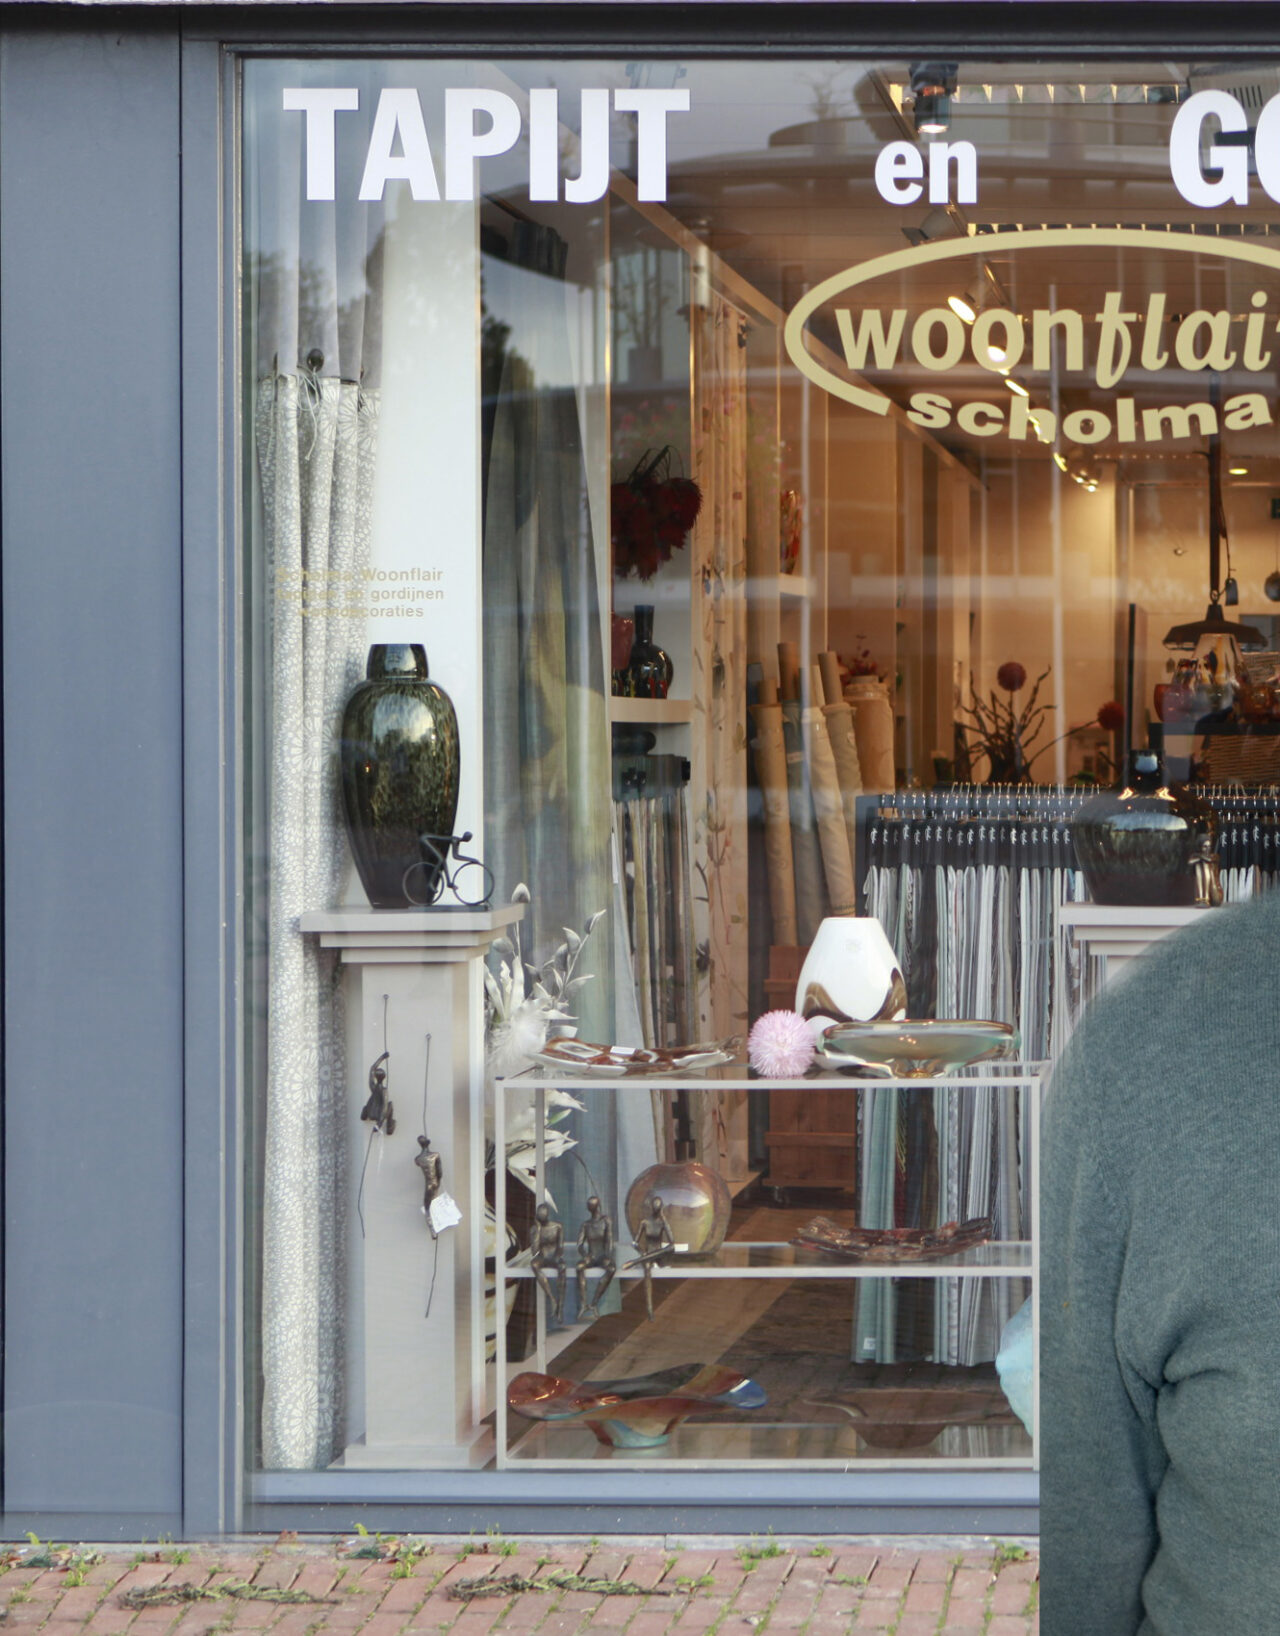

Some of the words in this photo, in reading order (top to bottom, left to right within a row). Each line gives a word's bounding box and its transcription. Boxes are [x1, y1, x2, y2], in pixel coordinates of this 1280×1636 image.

[281, 88, 691, 203] TAPIJT
[874, 140, 979, 206] en
[906, 392, 1274, 445] scholma
[360, 567, 444, 582] Woonflair
[371, 587, 444, 602] gordijnen
